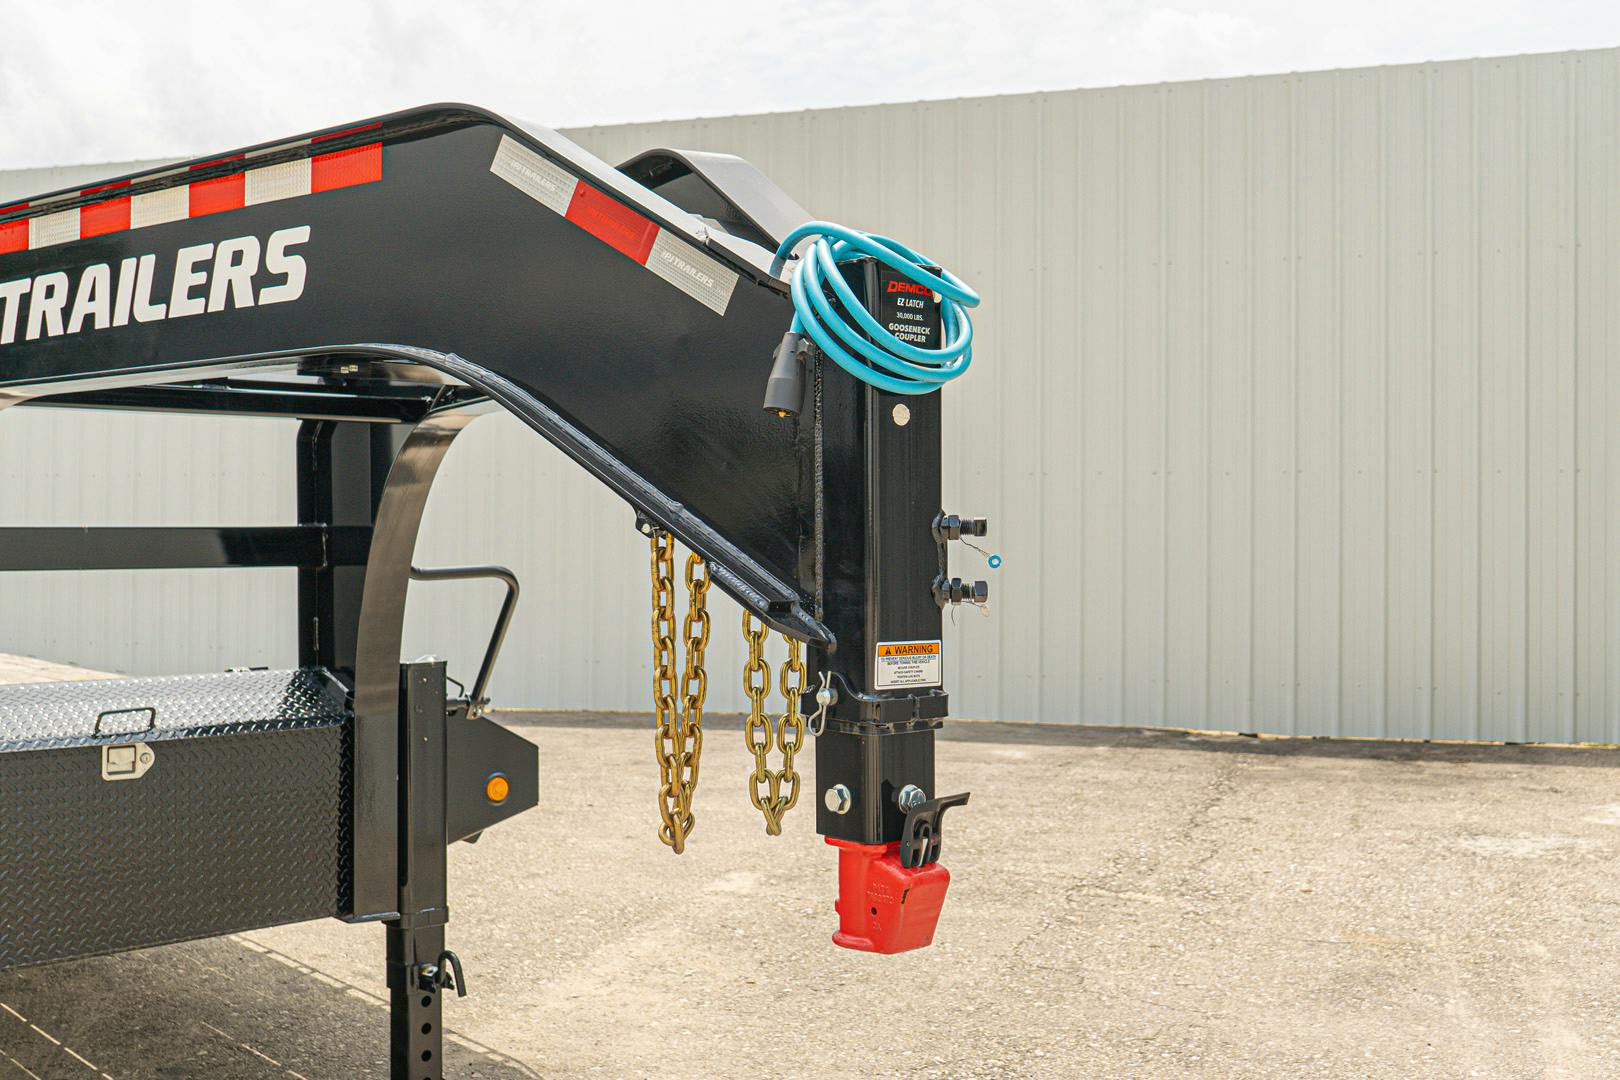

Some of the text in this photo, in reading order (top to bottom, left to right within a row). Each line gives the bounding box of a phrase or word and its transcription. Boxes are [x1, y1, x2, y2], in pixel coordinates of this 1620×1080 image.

[0, 225, 311, 345] TRAILERS
[896, 312, 913, 320] 30,000
[888, 323, 931, 335] GOOSENECK
[894, 332, 926, 343] COUPLER
[894, 644, 933, 655] WARNING
